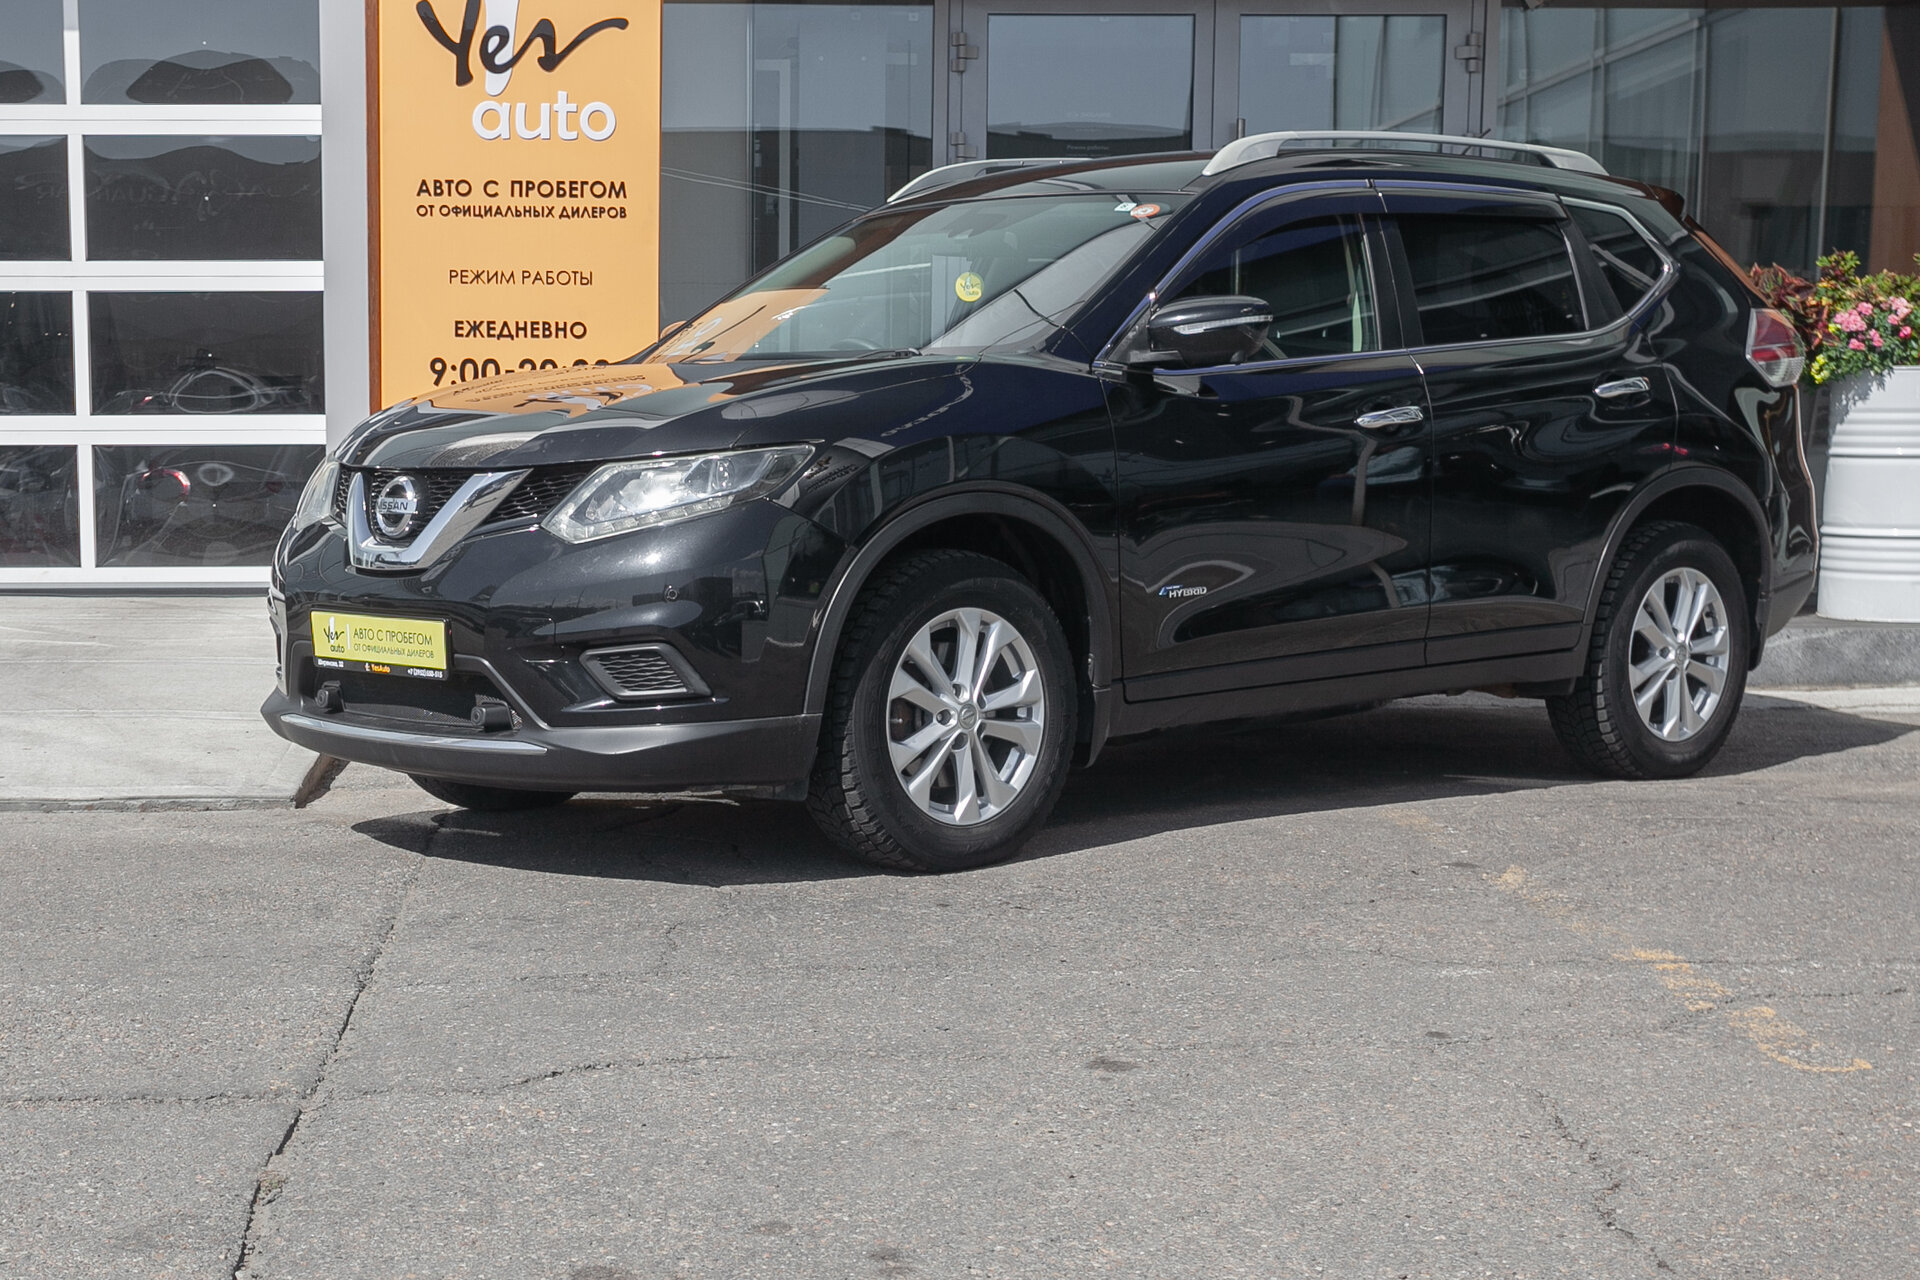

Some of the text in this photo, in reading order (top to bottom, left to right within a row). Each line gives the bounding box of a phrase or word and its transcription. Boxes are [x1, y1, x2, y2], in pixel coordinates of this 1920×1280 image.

[472, 90, 617, 141] auto
[416, 179, 627, 199] АВТО С ПРОБЕГОМ
[416, 204, 627, 219] ОТ ОФИЦИАЛЬНЫХ ДИЛЕРОВ
[449, 269, 593, 286] РЕЖИМ РАБОТЫ
[454, 320, 588, 340] ЕЖЕДНЕВНО
[1169, 586, 1208, 599] HYBRID
[353, 627, 433, 646] АВТО С ПРОБЕГОМ
[330, 643, 346, 653] auto
[353, 643, 435, 659] ОТ ОФИЦИАЛЬНЫХ ДИЛЕРОВ
